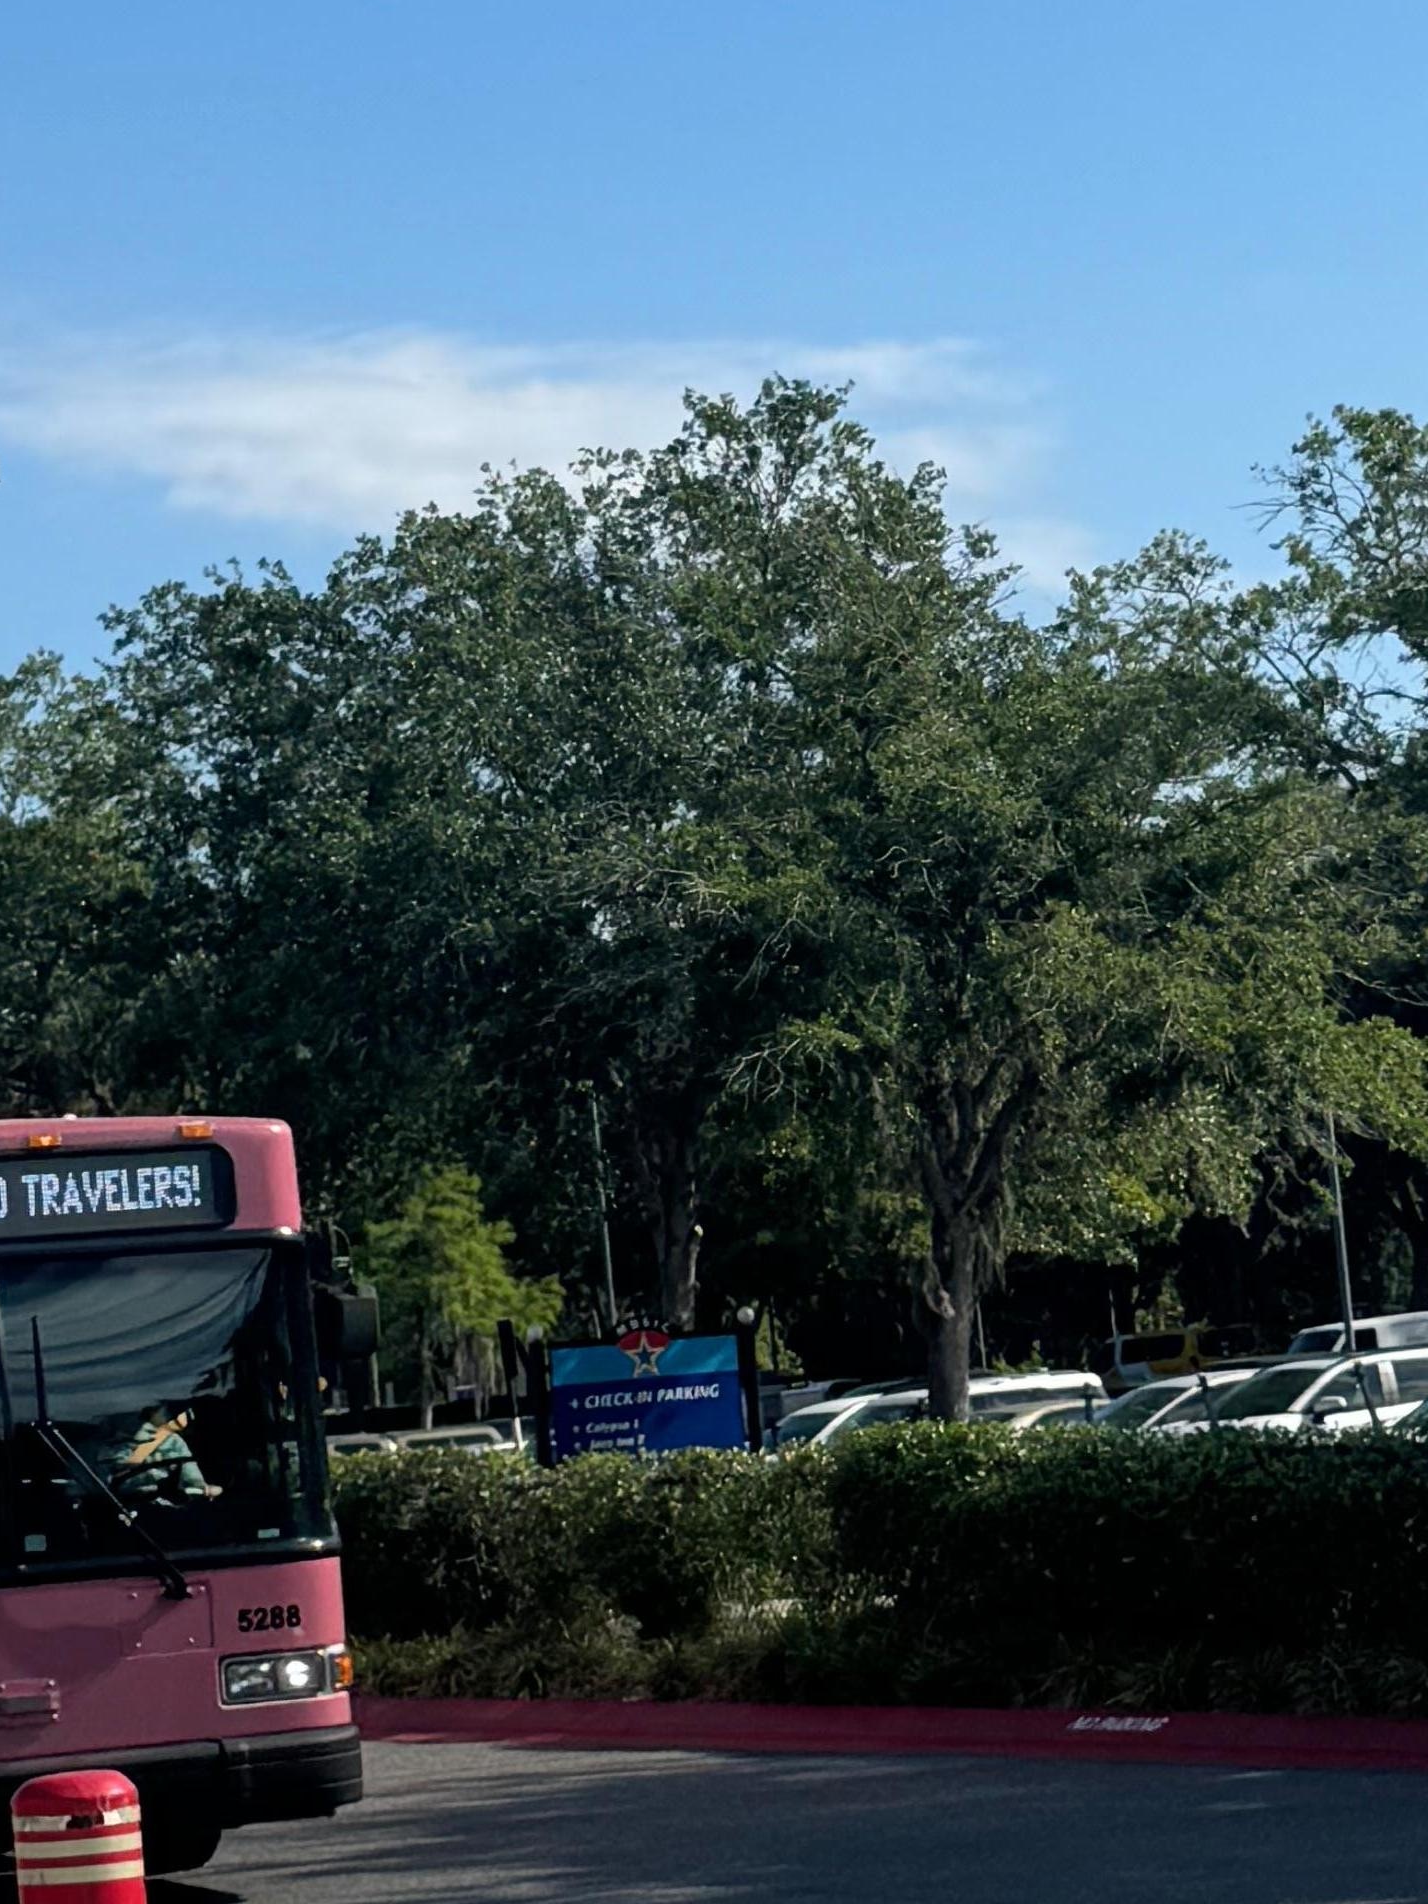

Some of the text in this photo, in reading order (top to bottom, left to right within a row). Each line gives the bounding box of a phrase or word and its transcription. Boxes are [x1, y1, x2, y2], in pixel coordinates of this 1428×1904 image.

[21, 1164, 202, 1217] TRAVELERS!
[656, 1383, 720, 1403] PARKING
[237, 1604, 302, 1633] 5288
